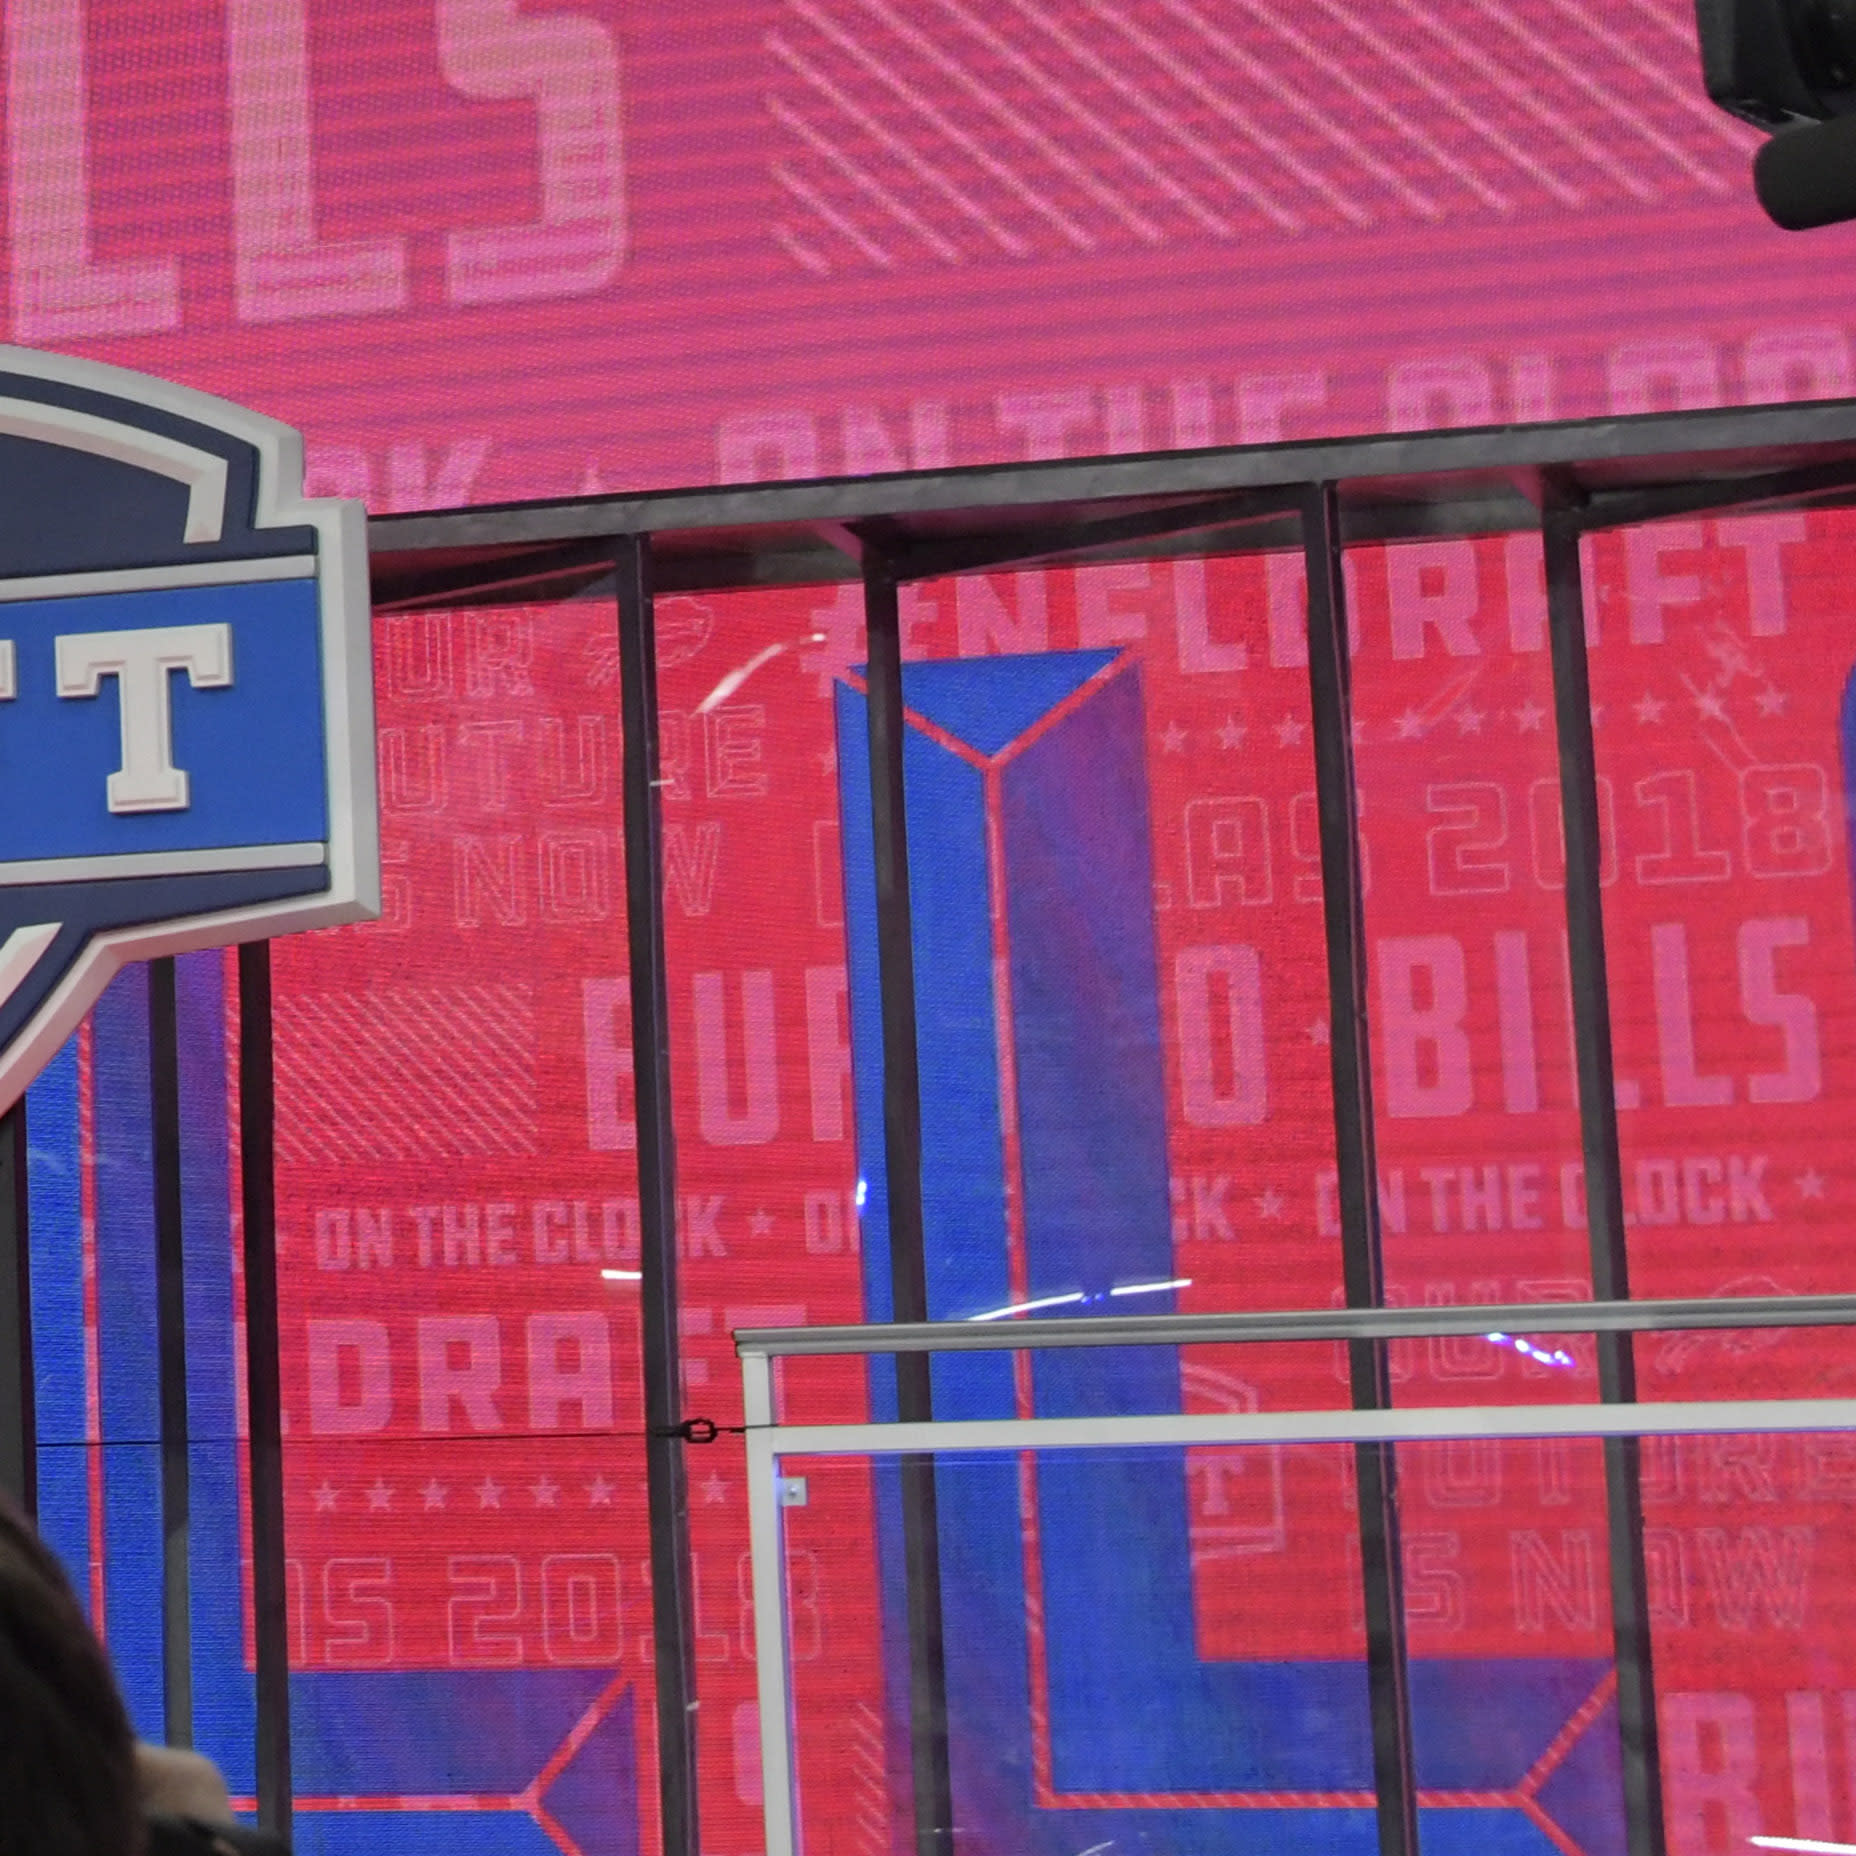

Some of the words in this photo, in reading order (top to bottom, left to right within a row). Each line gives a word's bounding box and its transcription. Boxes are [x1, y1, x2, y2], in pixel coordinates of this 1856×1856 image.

[314, 1206, 393, 1273] ON
[417, 1201, 517, 1270] THE
[532, 1194, 728, 1266] CLOK
[1421, 1160, 1544, 1234] THE
